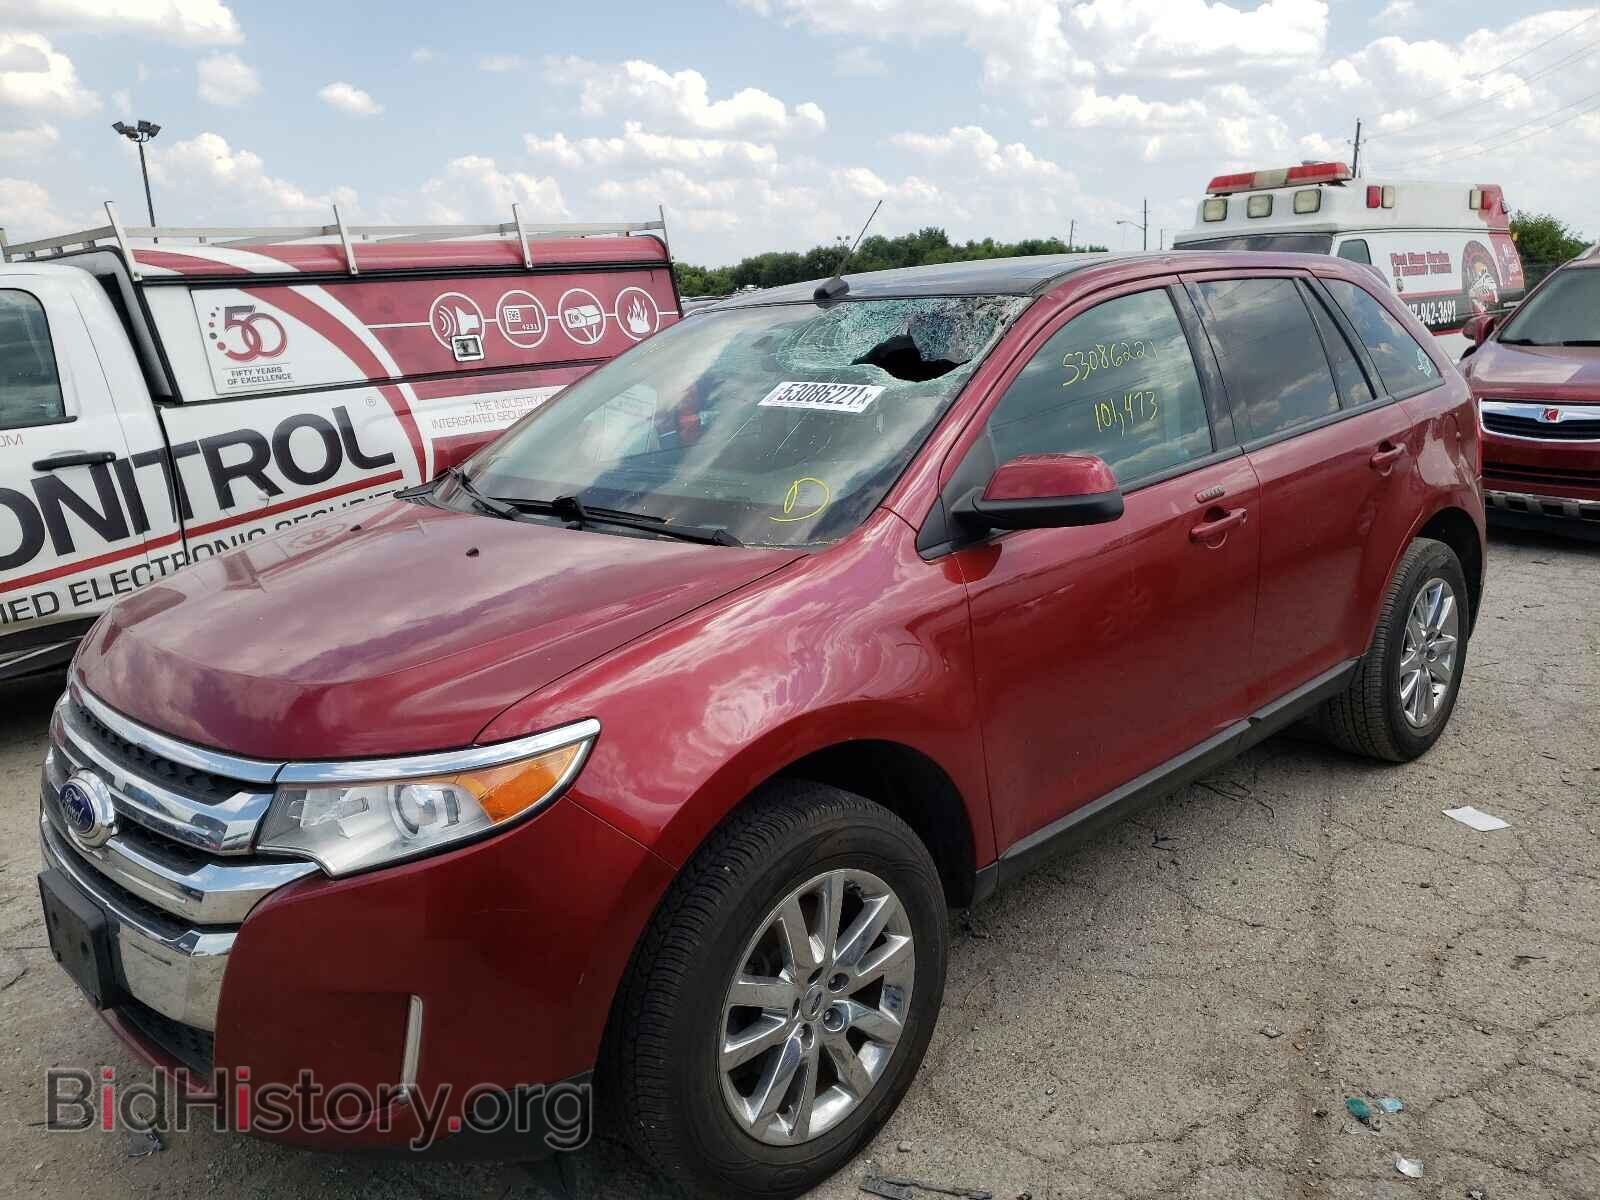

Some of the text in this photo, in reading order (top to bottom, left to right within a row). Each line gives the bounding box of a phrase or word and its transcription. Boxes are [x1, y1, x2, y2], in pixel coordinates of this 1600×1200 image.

[231, 366, 283, 378] FIFTY YEARS
[227, 373, 293, 386] OF EXCELLENCE
[777, 383, 868, 406] 53086221
